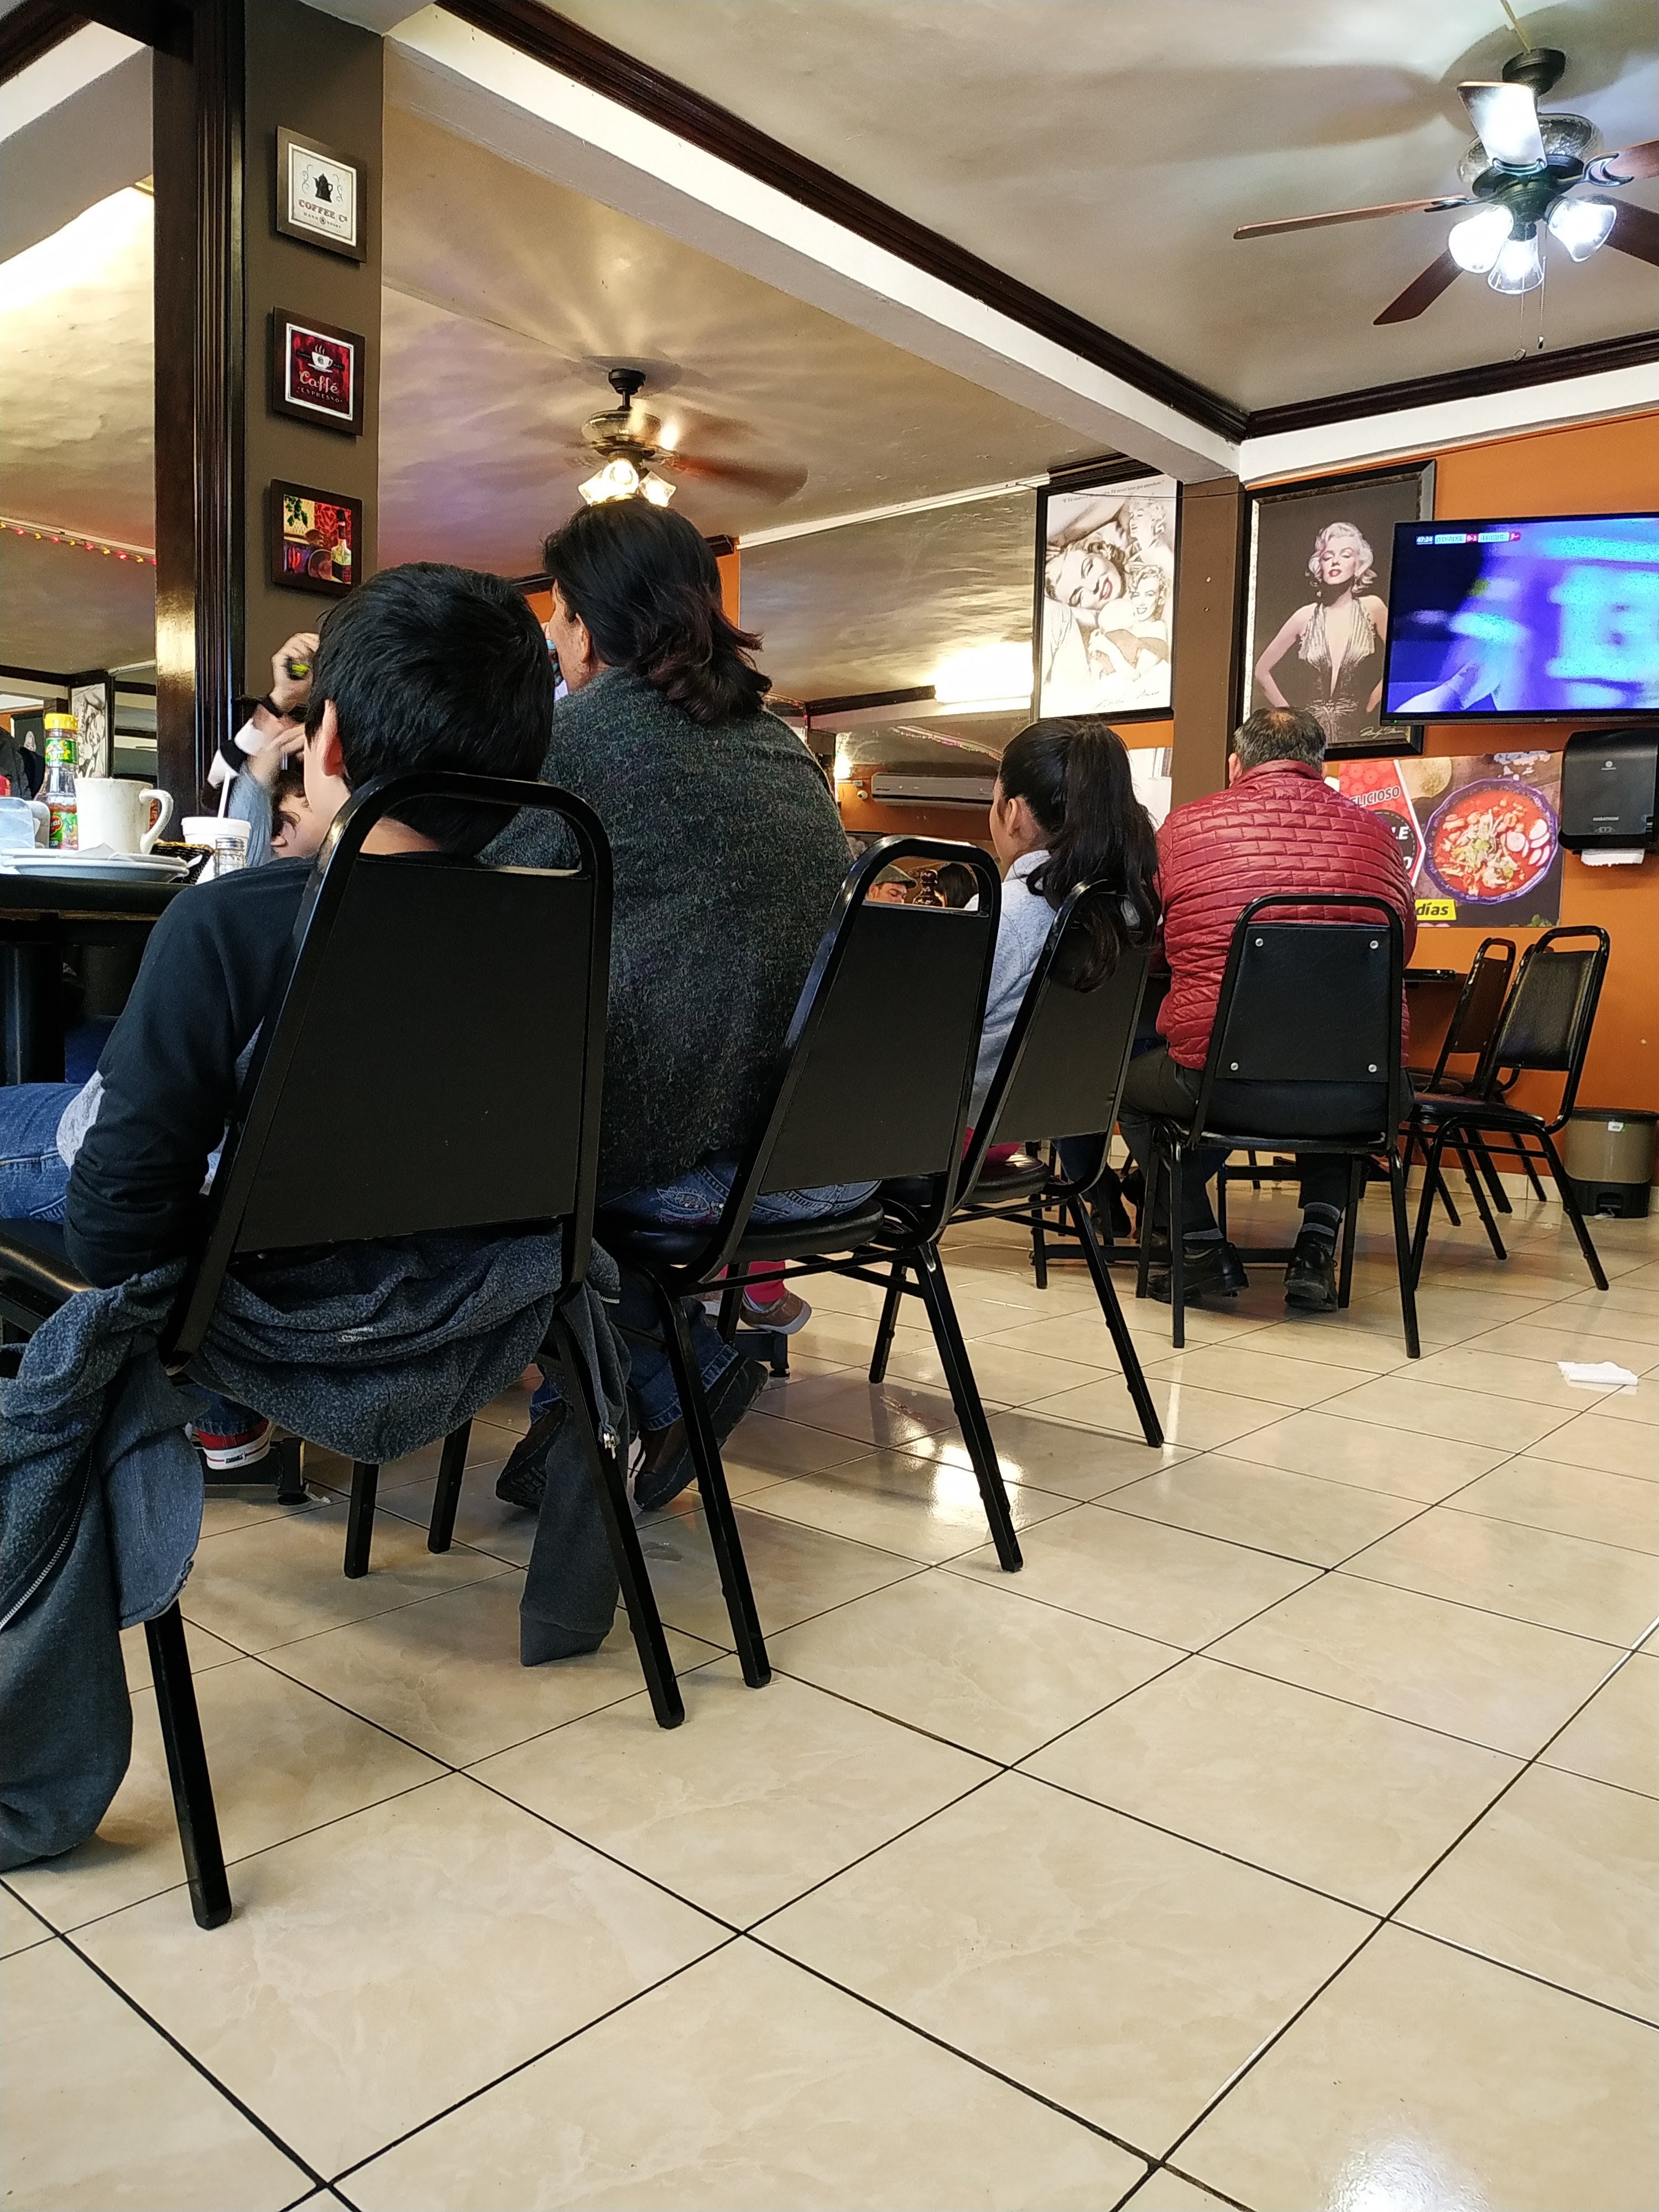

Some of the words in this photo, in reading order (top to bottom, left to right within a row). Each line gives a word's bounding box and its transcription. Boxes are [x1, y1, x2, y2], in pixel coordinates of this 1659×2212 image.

[299, 199, 336, 220] COFFEE
[299, 371, 339, 394] Caffé
[1351, 786, 1400, 806] LICIOSO
[1416, 902, 1449, 916] días
